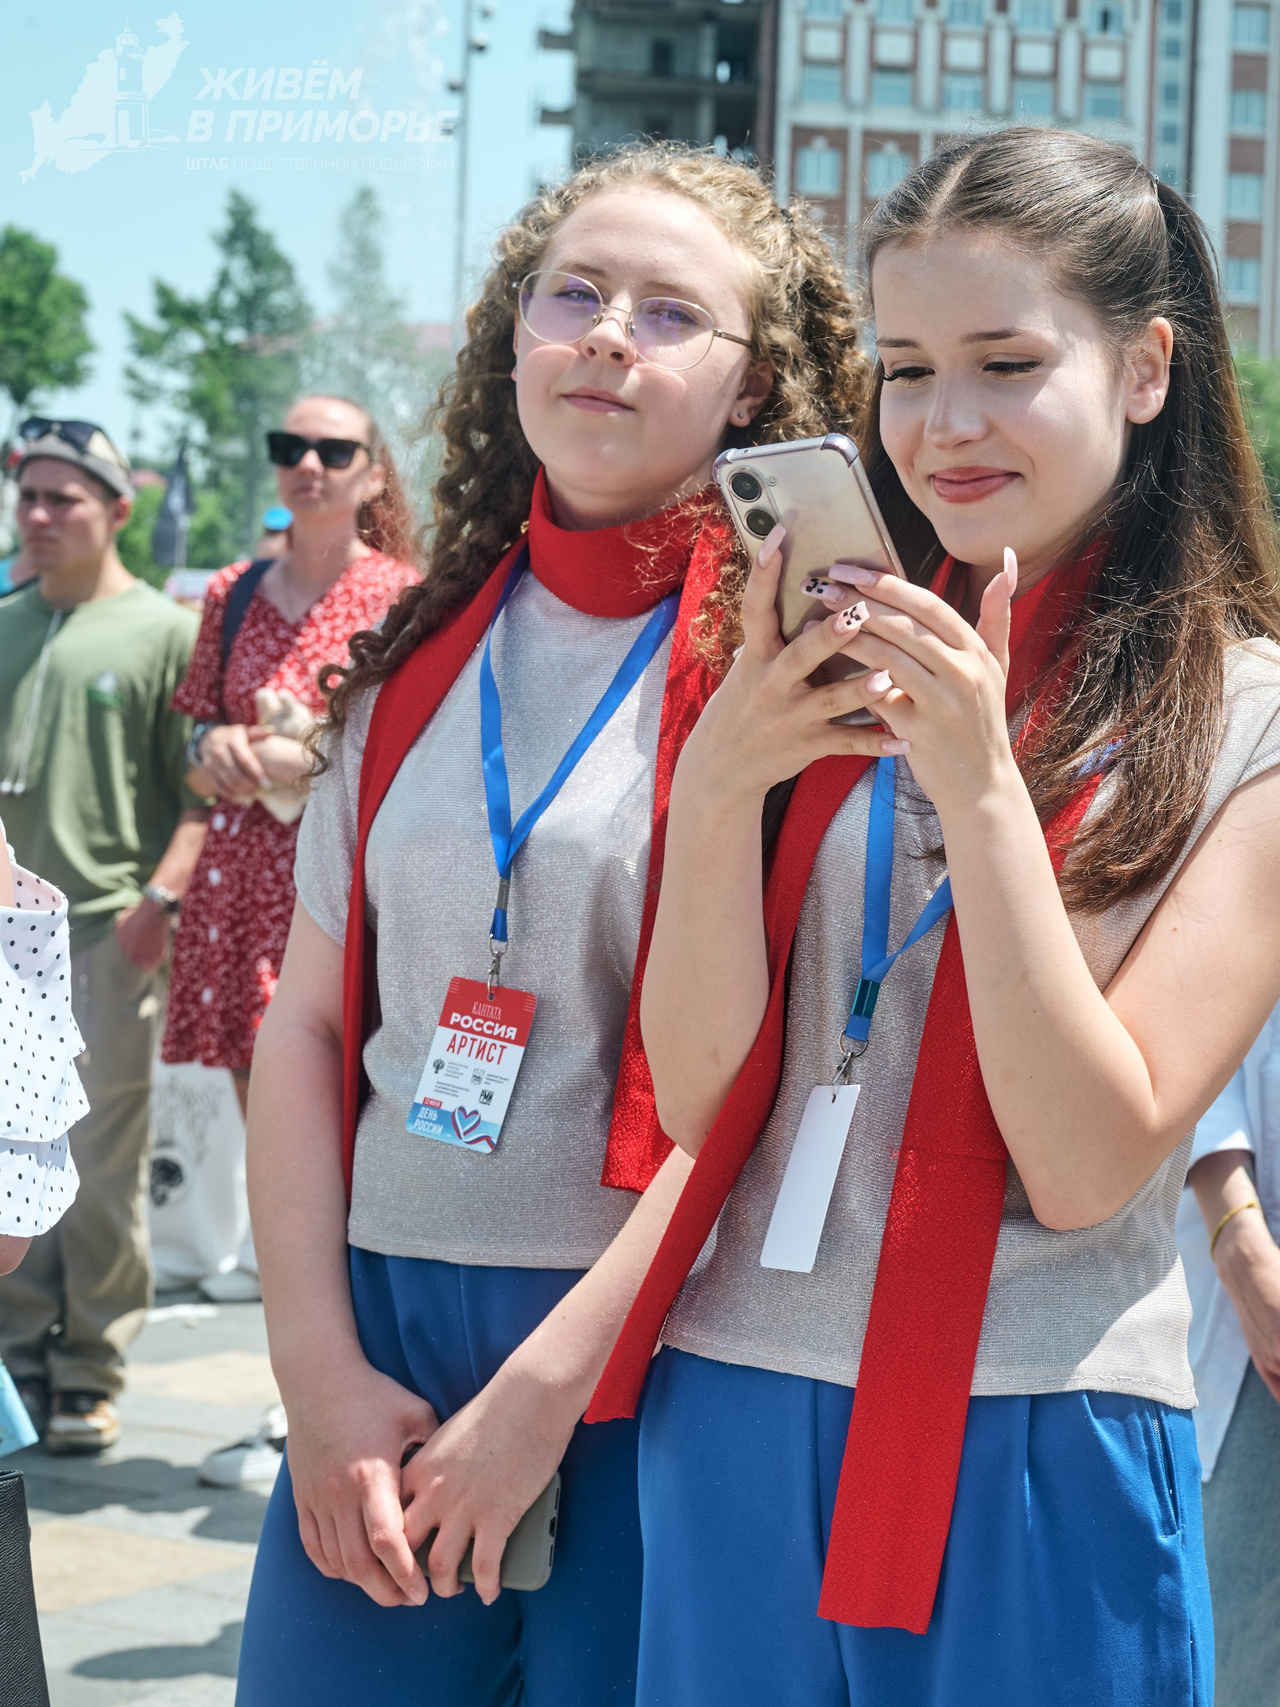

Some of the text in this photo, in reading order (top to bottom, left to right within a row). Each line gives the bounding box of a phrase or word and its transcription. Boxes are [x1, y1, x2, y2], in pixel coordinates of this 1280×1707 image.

[472, 1001, 502, 1020] КАНТАТА
[449, 1012, 518, 1040] РОССИЯ
[446, 1033, 507, 1065] АРТИСТ
[417, 1106, 438, 1121] ДЕНЬ
[413, 1119, 444, 1136] РОССИИ
